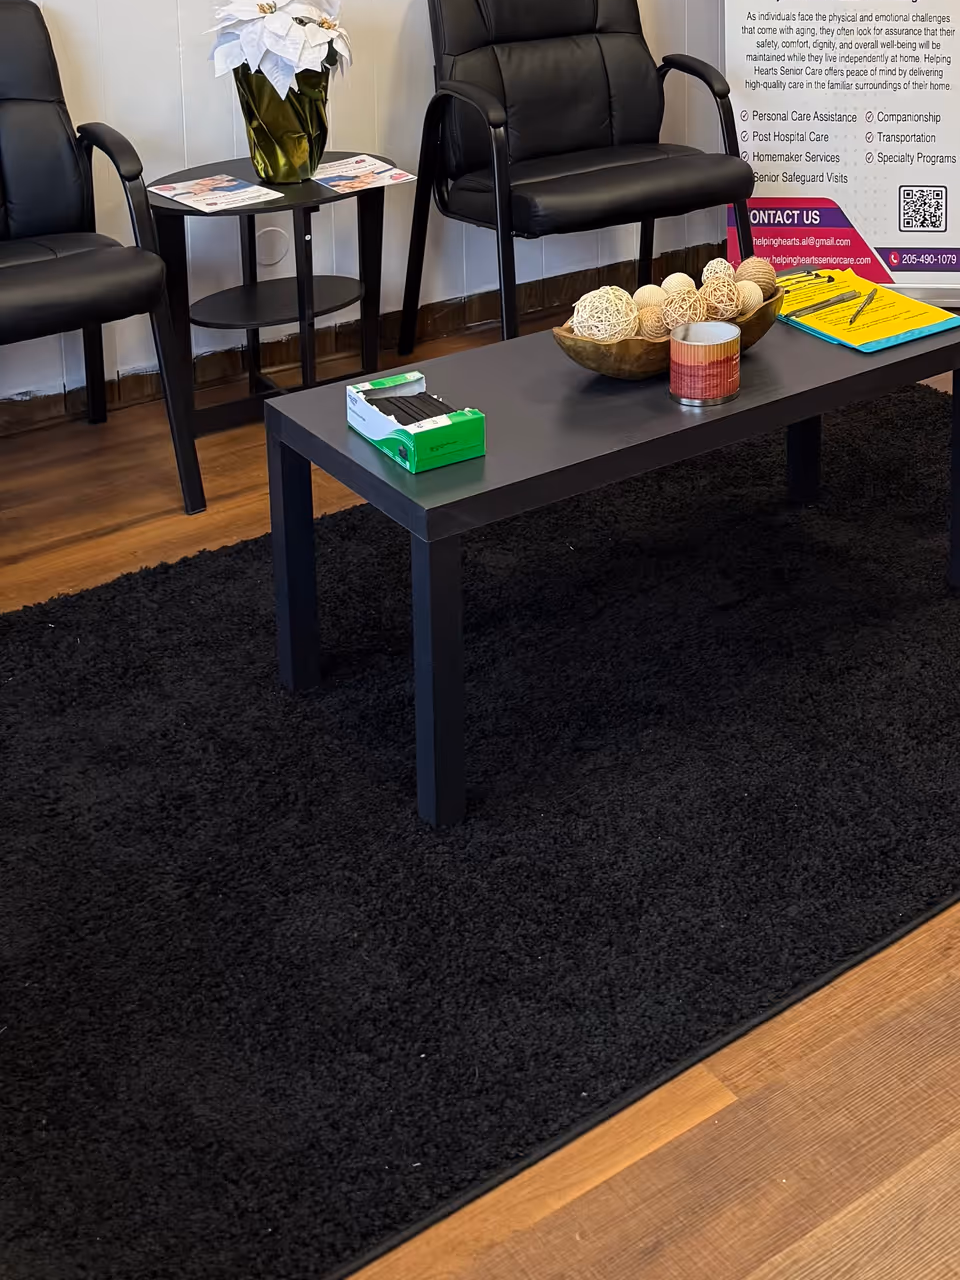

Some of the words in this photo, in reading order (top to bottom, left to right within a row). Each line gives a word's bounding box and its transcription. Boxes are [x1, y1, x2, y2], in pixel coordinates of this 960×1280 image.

[746, 12, 756, 21] As
[758, 12, 796, 21] individuals
[798, 12, 814, 21] face
[816, 12, 826, 22] the
[828, 12, 858, 24] physical
[860, 13, 873, 22] and
[874, 13, 910, 22] emotional
[911, 13, 950, 24] challenges
[741, 26, 756, 34] that
[757, 26, 778, 34] come
[779, 26, 794, 34] with
[796, 26, 818, 36] aging,
[820, 26, 834, 37] they
[836, 26, 854, 36] often
[856, 26, 872, 36] look
[874, 26, 883, 36] for
[884, 28, 922, 36] assurance
[924, 27, 938, 36] that
[940, 27, 956, 36] their
[756, 39, 780, 50] safety,
[781, 39, 810, 50] comfort,
[812, 40, 837, 51] dignity,
[838, 40, 852, 50] and
[854, 40, 878, 50] overall
[880, 40, 916, 52] well-being
[918, 40, 930, 50] will
[932, 41, 941, 50] be
[746, 53, 786, 62] maintained
[787, 53, 806, 62] while
[808, 53, 824, 64] they
[824, 54, 836, 62] live
[838, 54, 889, 64] independently
[890, 54, 898, 63] at
[900, 54, 922, 63] home.
[924, 54, 952, 66] Helping
[754, 66, 778, 76] Hearts
[780, 66, 804, 76] Senior
[804, 66, 822, 76] Care
[824, 66, 844, 76] offers
[846, 69, 868, 78] peace
[870, 67, 878, 76] of
[878, 68, 896, 76] mind
[898, 67, 908, 78] by
[908, 68, 944, 79] delivering
[744, 80, 786, 90] high-quality
[806, 80, 812, 89] in
[814, 80, 826, 89] the
[828, 80, 853, 90] familiar
[854, 80, 902, 92] surroundings
[902, 80, 911, 90] of
[912, 81, 928, 90] their
[930, 81, 952, 91] home.
[752, 110, 788, 121] Personal
[790, 110, 812, 122] Care
[812, 111, 857, 122] Assistance
[877, 111, 941, 124] Companionship
[752, 130, 772, 142] Post
[773, 131, 806, 144] Hospital
[808, 131, 829, 142] Care
[878, 132, 936, 144] Transportation
[752, 152, 802, 162] Homemaker
[804, 152, 840, 163] Services
[878, 152, 914, 165] Specialty
[916, 152, 957, 165] Programs
[753, 172, 780, 182] Senior
[782, 172, 824, 185] Safeguard
[826, 172, 848, 184] Visits
[748, 210, 800, 224] ONTACT
[804, 210, 820, 224] US
[753, 236, 850, 248] helpinghearts.al@gmail.com
[760, 255, 872, 266] w.helpingheartsseniorcare.com
[902, 254, 956, 265] 205-490-1079
